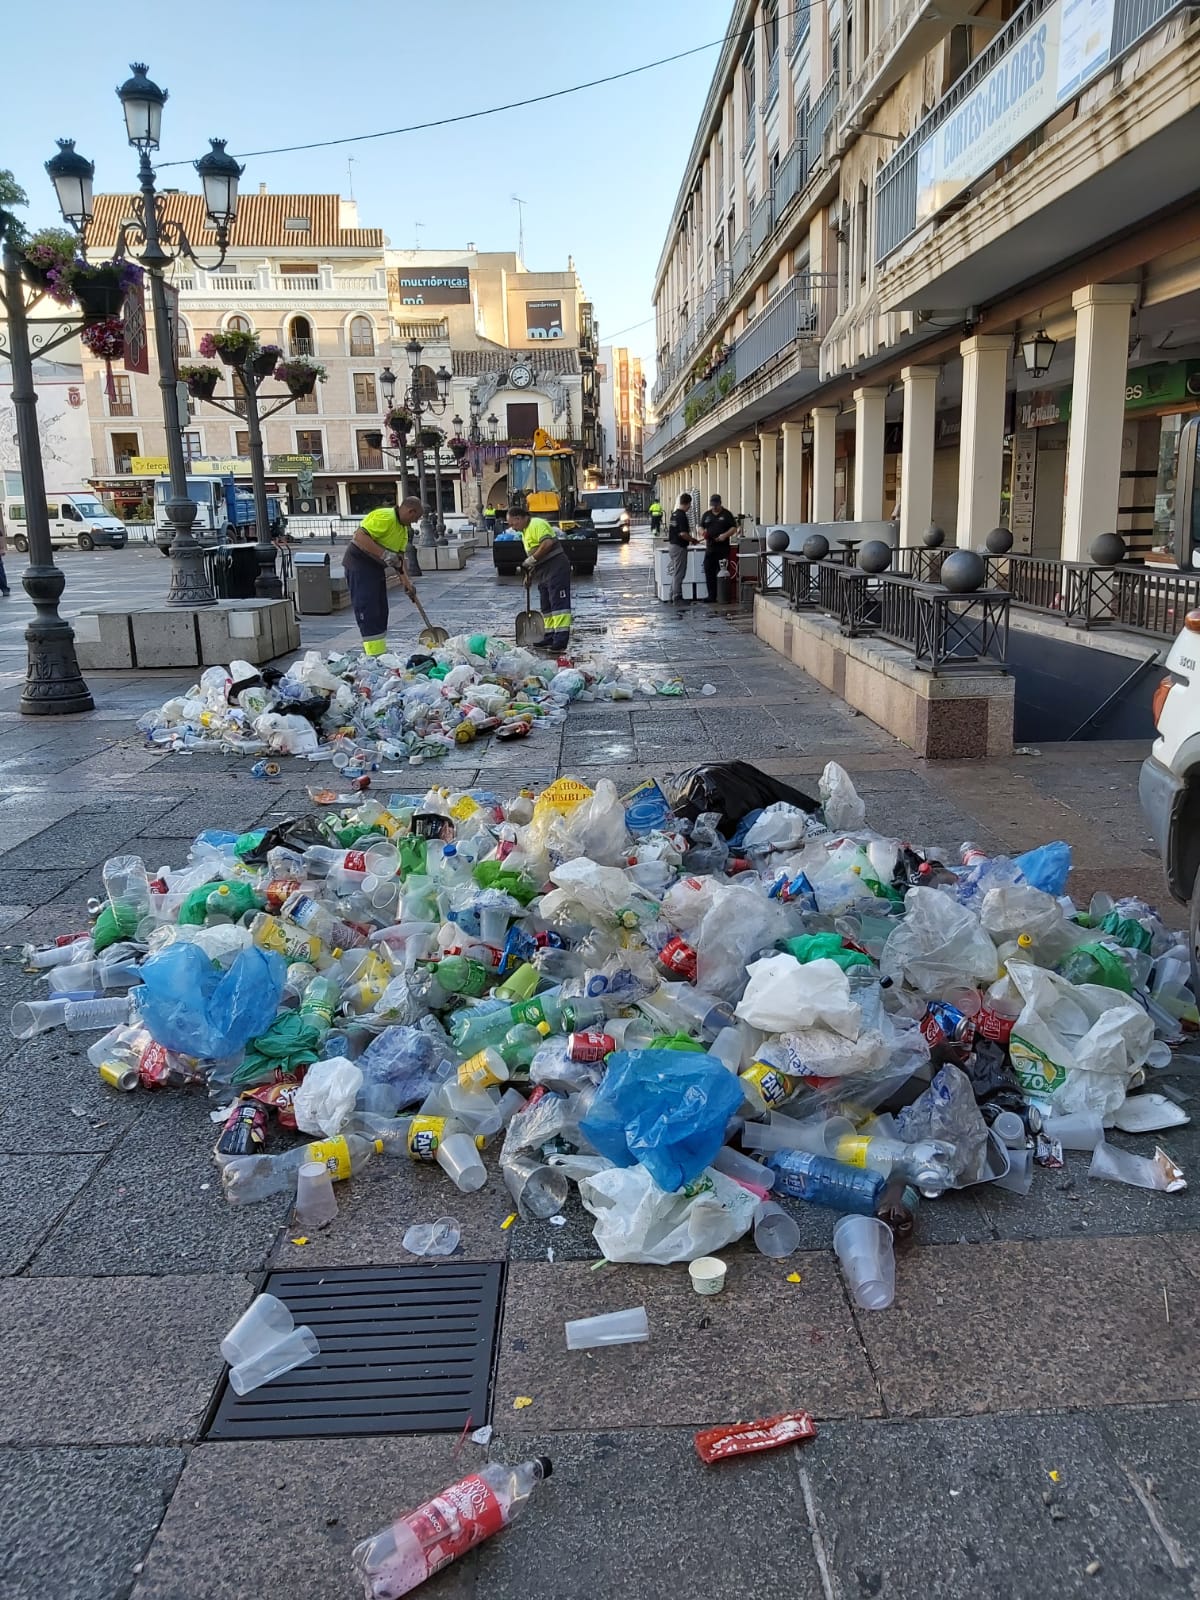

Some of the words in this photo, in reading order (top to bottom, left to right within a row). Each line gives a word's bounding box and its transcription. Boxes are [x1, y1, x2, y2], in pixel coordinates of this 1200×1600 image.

[943, 91, 982, 170] CORTES
[988, 23, 1048, 127] COLORES
[761, 1072, 786, 1104] FANT
[1021, 1074, 1054, 1093] 70%
[416, 1131, 433, 1160] FANT
[471, 1479, 490, 1499] DON
